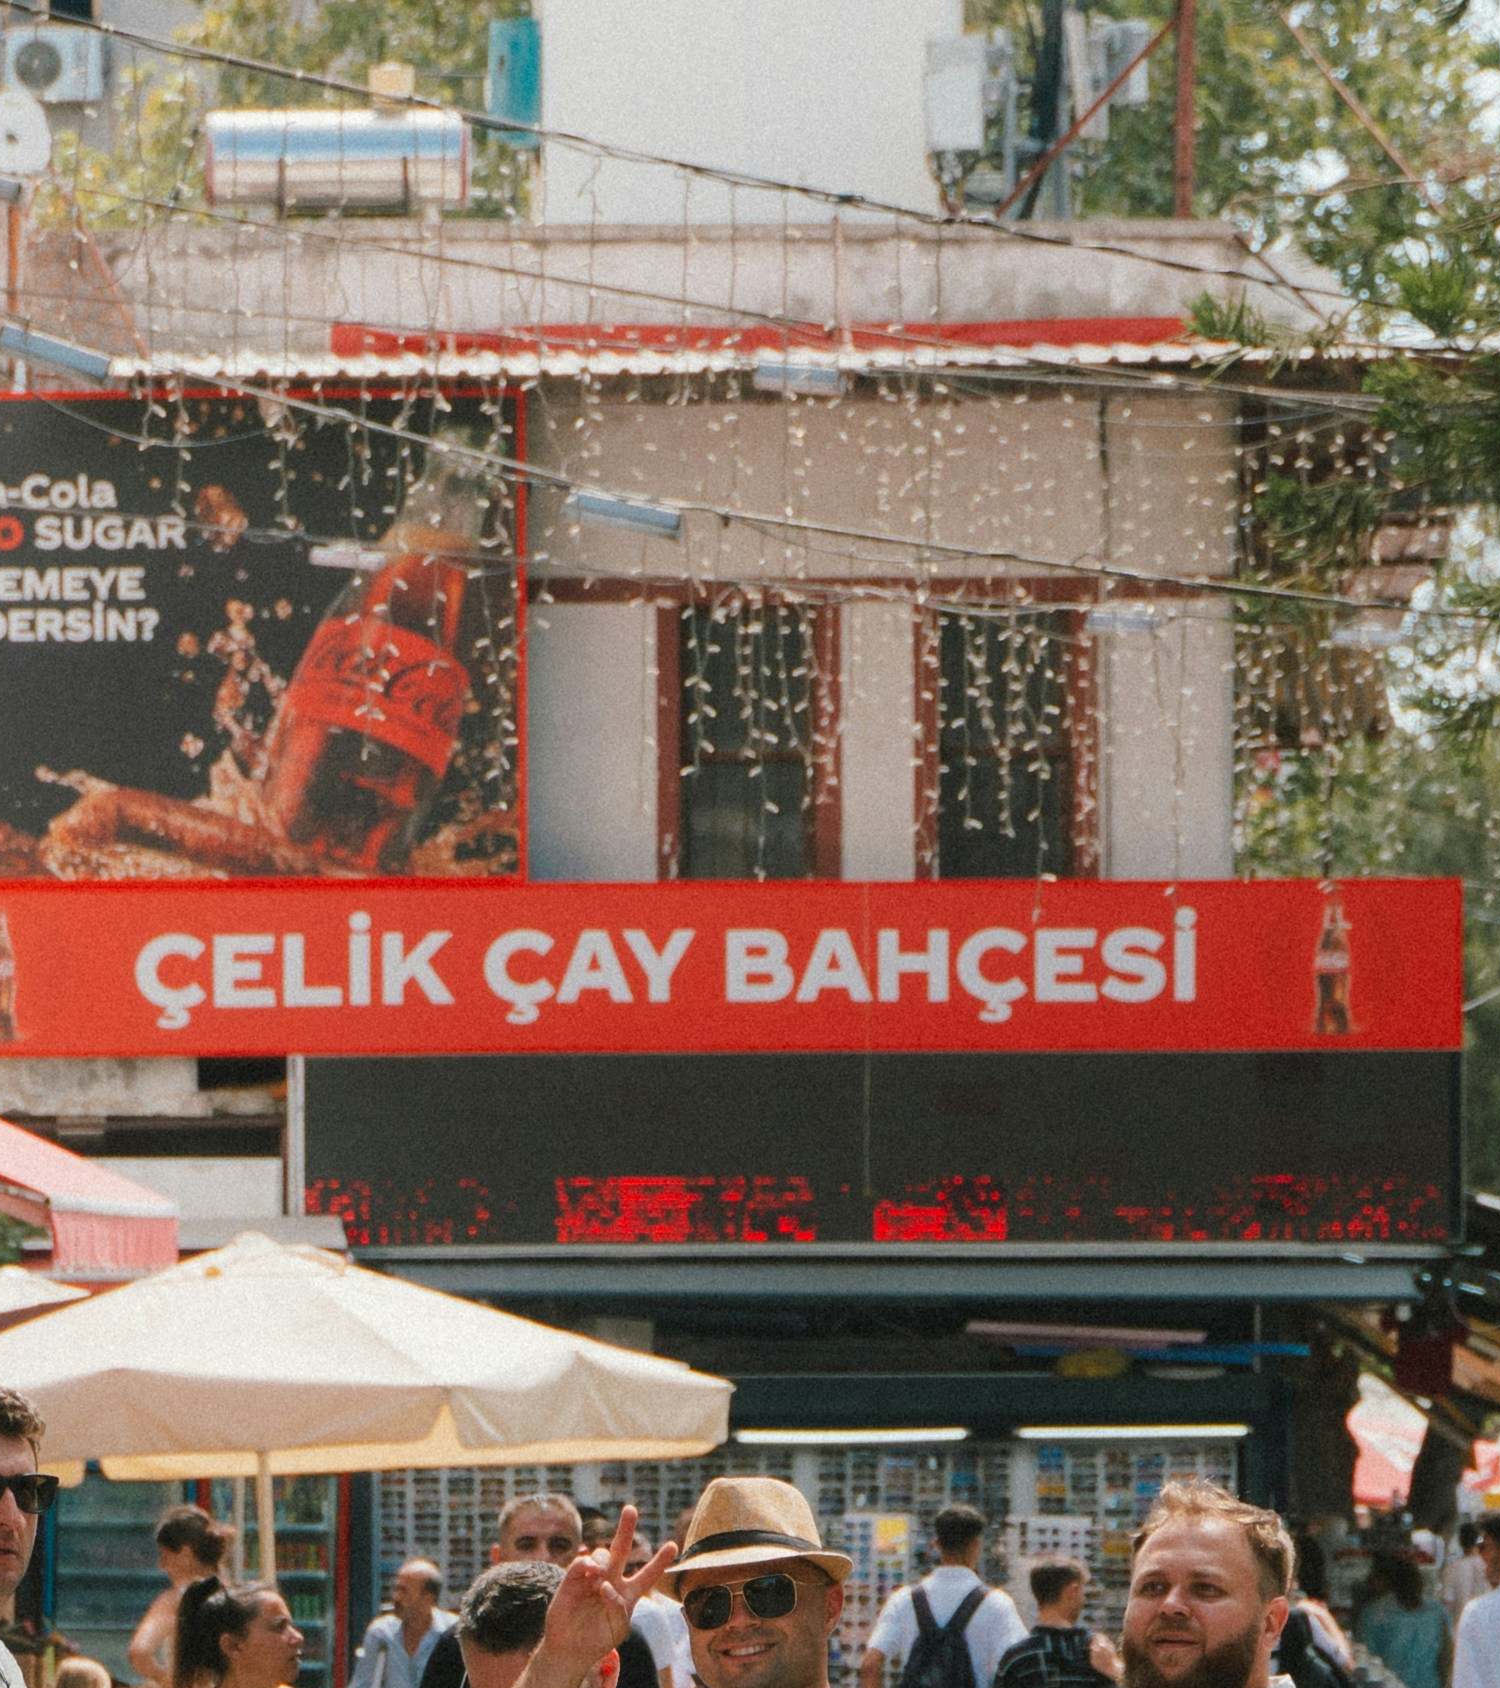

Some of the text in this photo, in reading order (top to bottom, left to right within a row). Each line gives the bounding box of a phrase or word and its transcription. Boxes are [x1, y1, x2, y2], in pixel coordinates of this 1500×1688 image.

[34, 515, 188, 551] SUGAR
[134, 905, 1199, 1030] ÇELİK ÇAY BAHÇESİ
